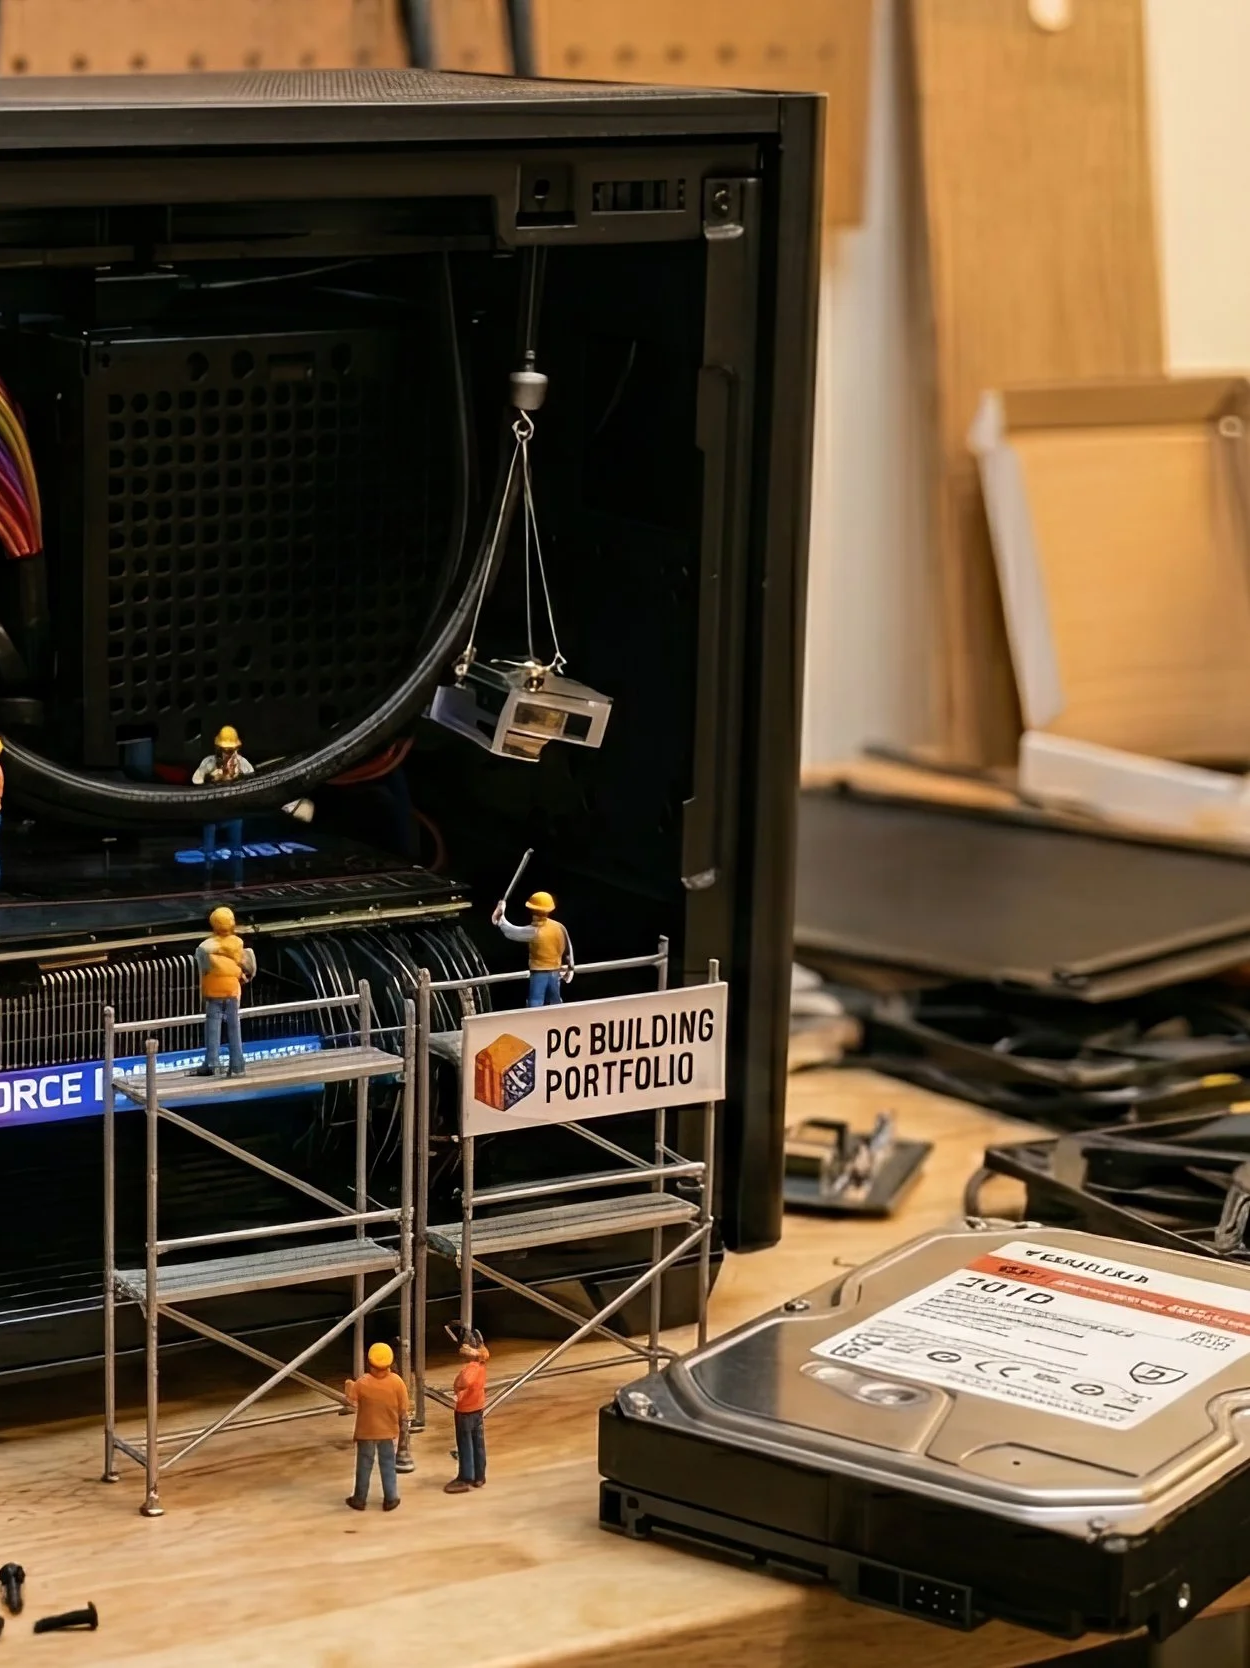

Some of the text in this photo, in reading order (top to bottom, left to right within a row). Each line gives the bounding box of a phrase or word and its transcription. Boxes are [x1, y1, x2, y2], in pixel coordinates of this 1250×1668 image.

[547, 1008, 713, 1058] PC BUILDING
[546, 1052, 693, 1103] PORTFOLIO
